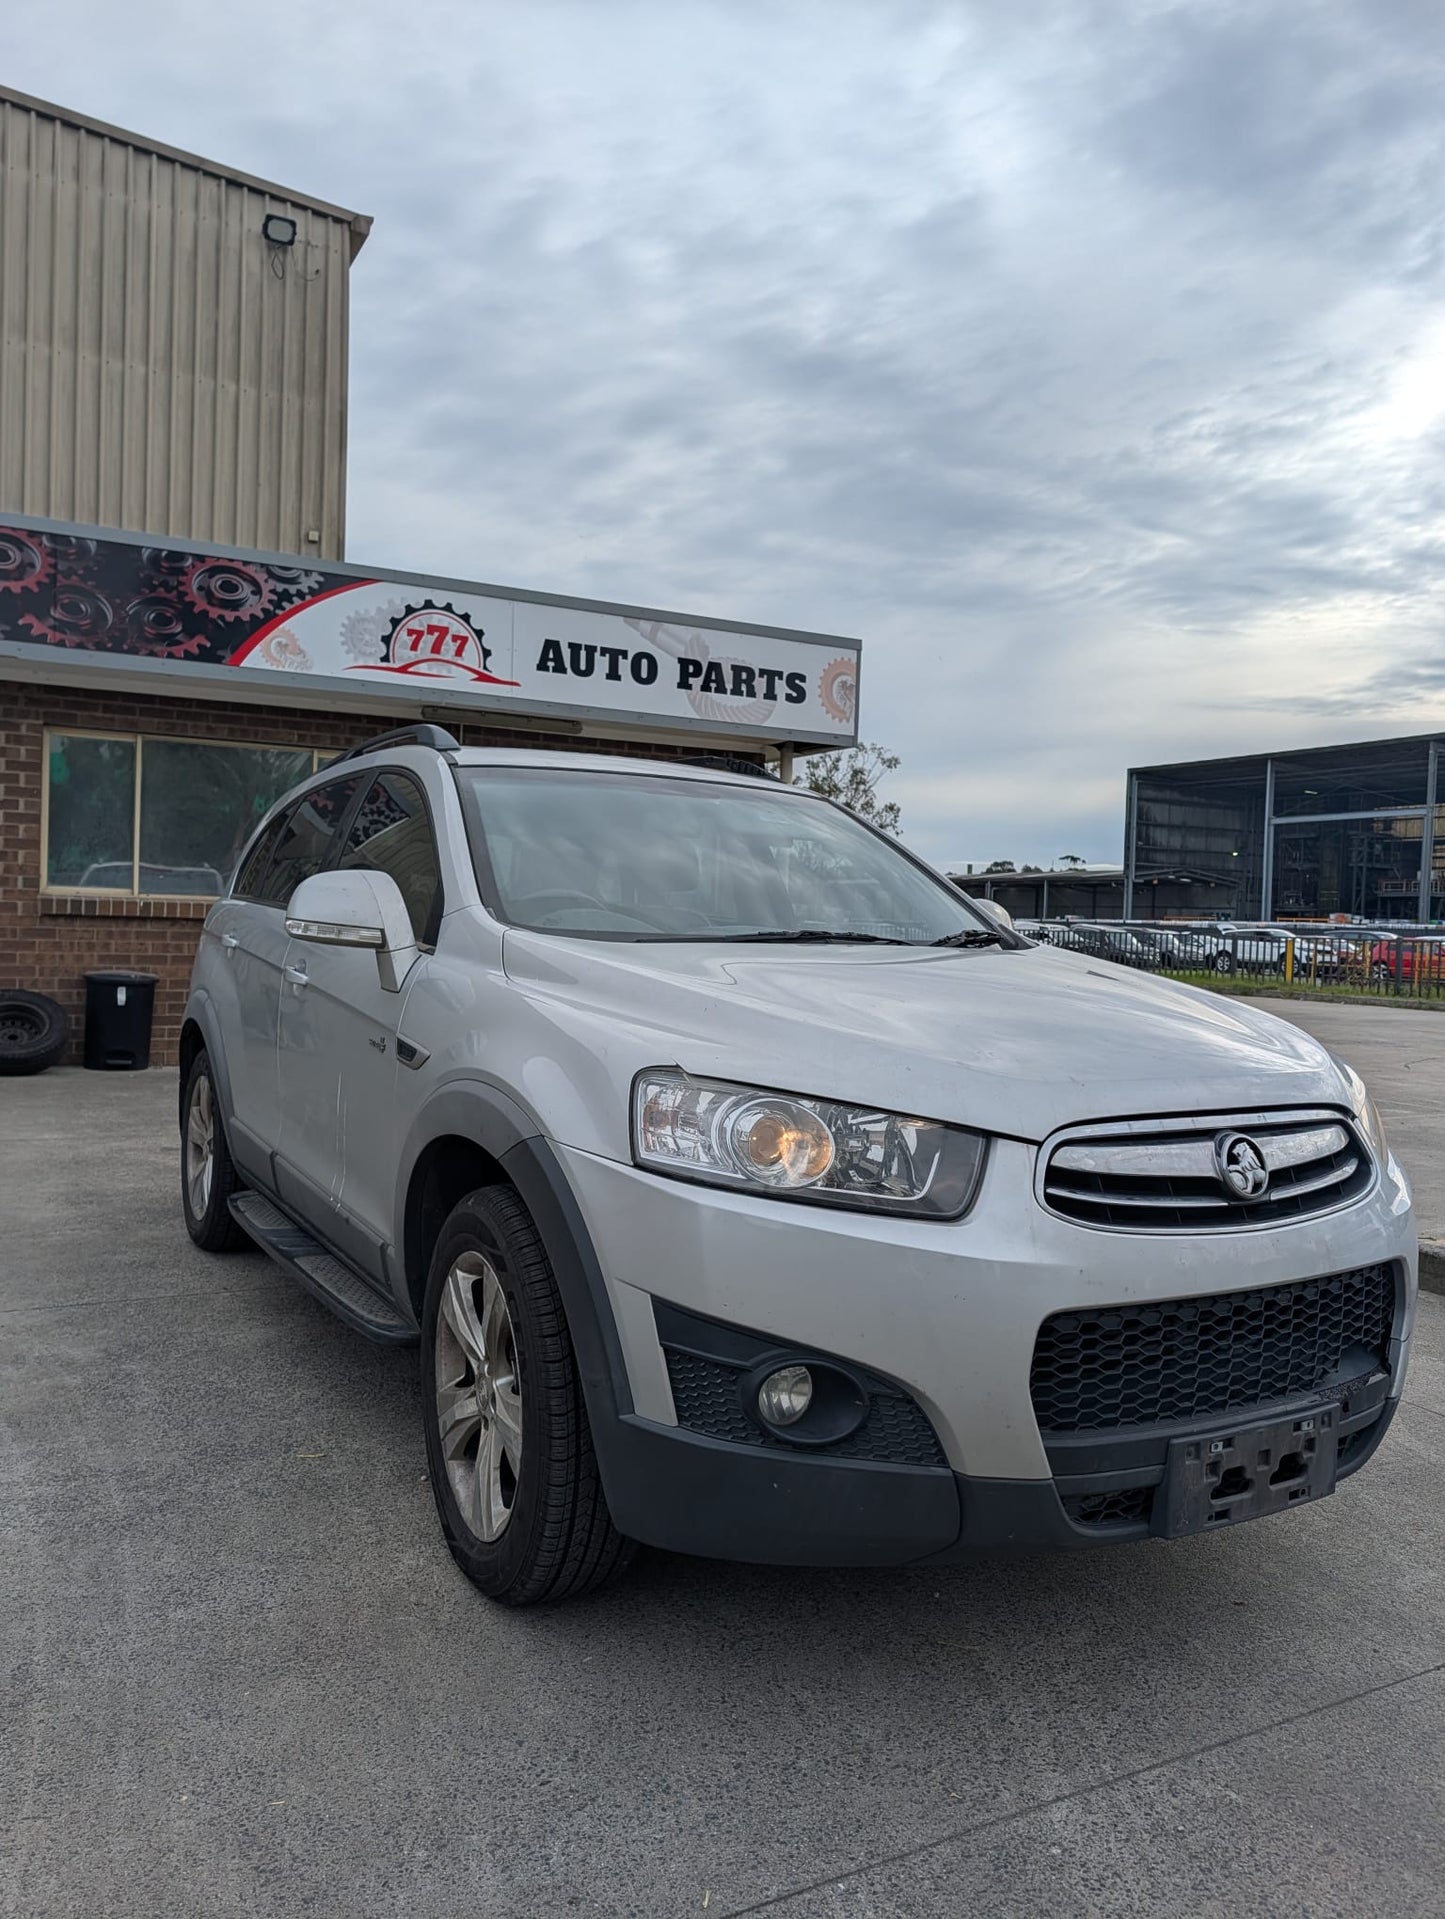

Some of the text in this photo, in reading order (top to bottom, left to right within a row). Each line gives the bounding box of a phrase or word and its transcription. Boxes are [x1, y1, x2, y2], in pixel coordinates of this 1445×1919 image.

[406, 624, 470, 658] 777
[536, 638, 807, 704] AUTO PARTS
